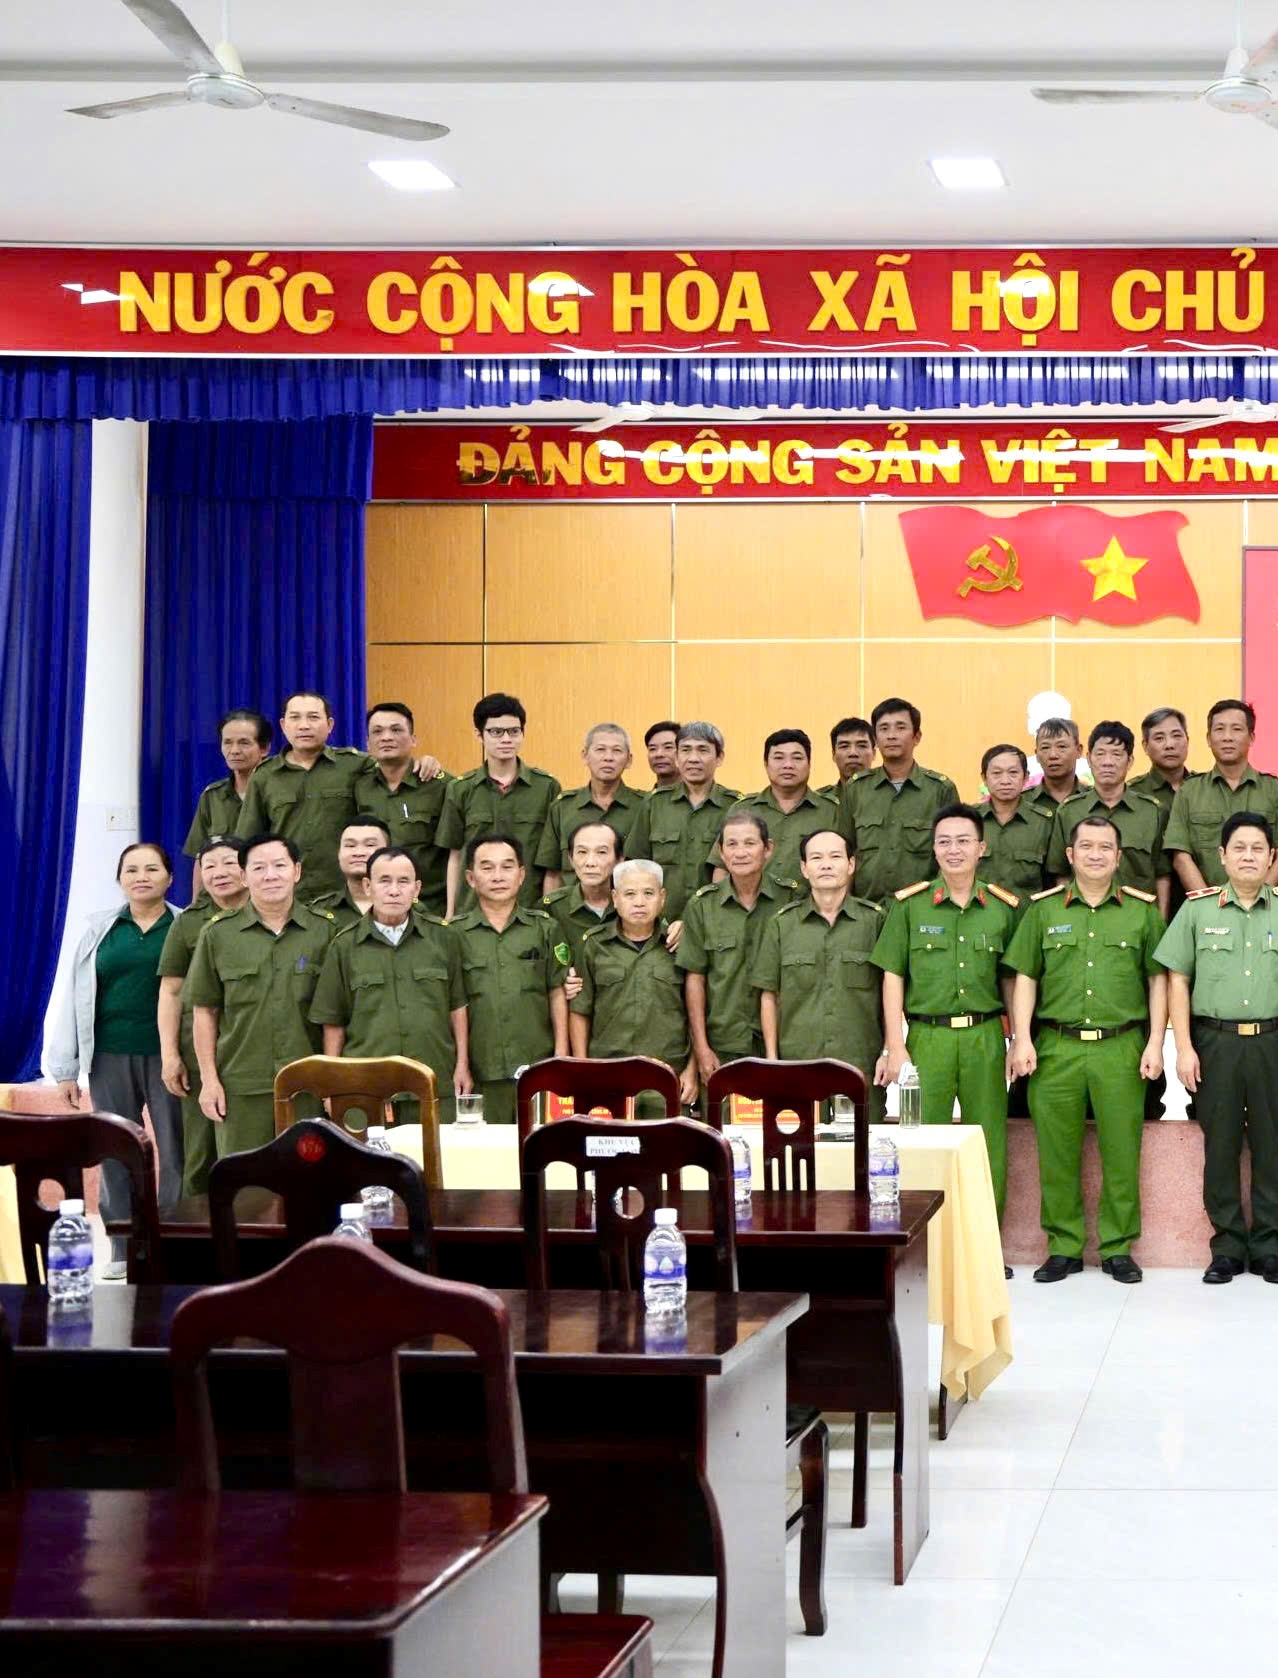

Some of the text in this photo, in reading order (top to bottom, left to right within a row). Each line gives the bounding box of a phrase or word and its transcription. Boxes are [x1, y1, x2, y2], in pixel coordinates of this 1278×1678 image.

[120, 252, 334, 333] NƯỚC
[366, 256, 581, 352] CỘNG
[612, 252, 769, 333] HÒA
[808, 252, 916, 333] XÃ
[952, 252, 1080, 347] HỘI
[1111, 246, 1266, 333] CHỦ
[456, 424, 625, 487] ĐẢNG
[640, 429, 812, 496] CỘNG
[834, 423, 964, 486] SẢN
[985, 429, 1119, 494] VIỆT
